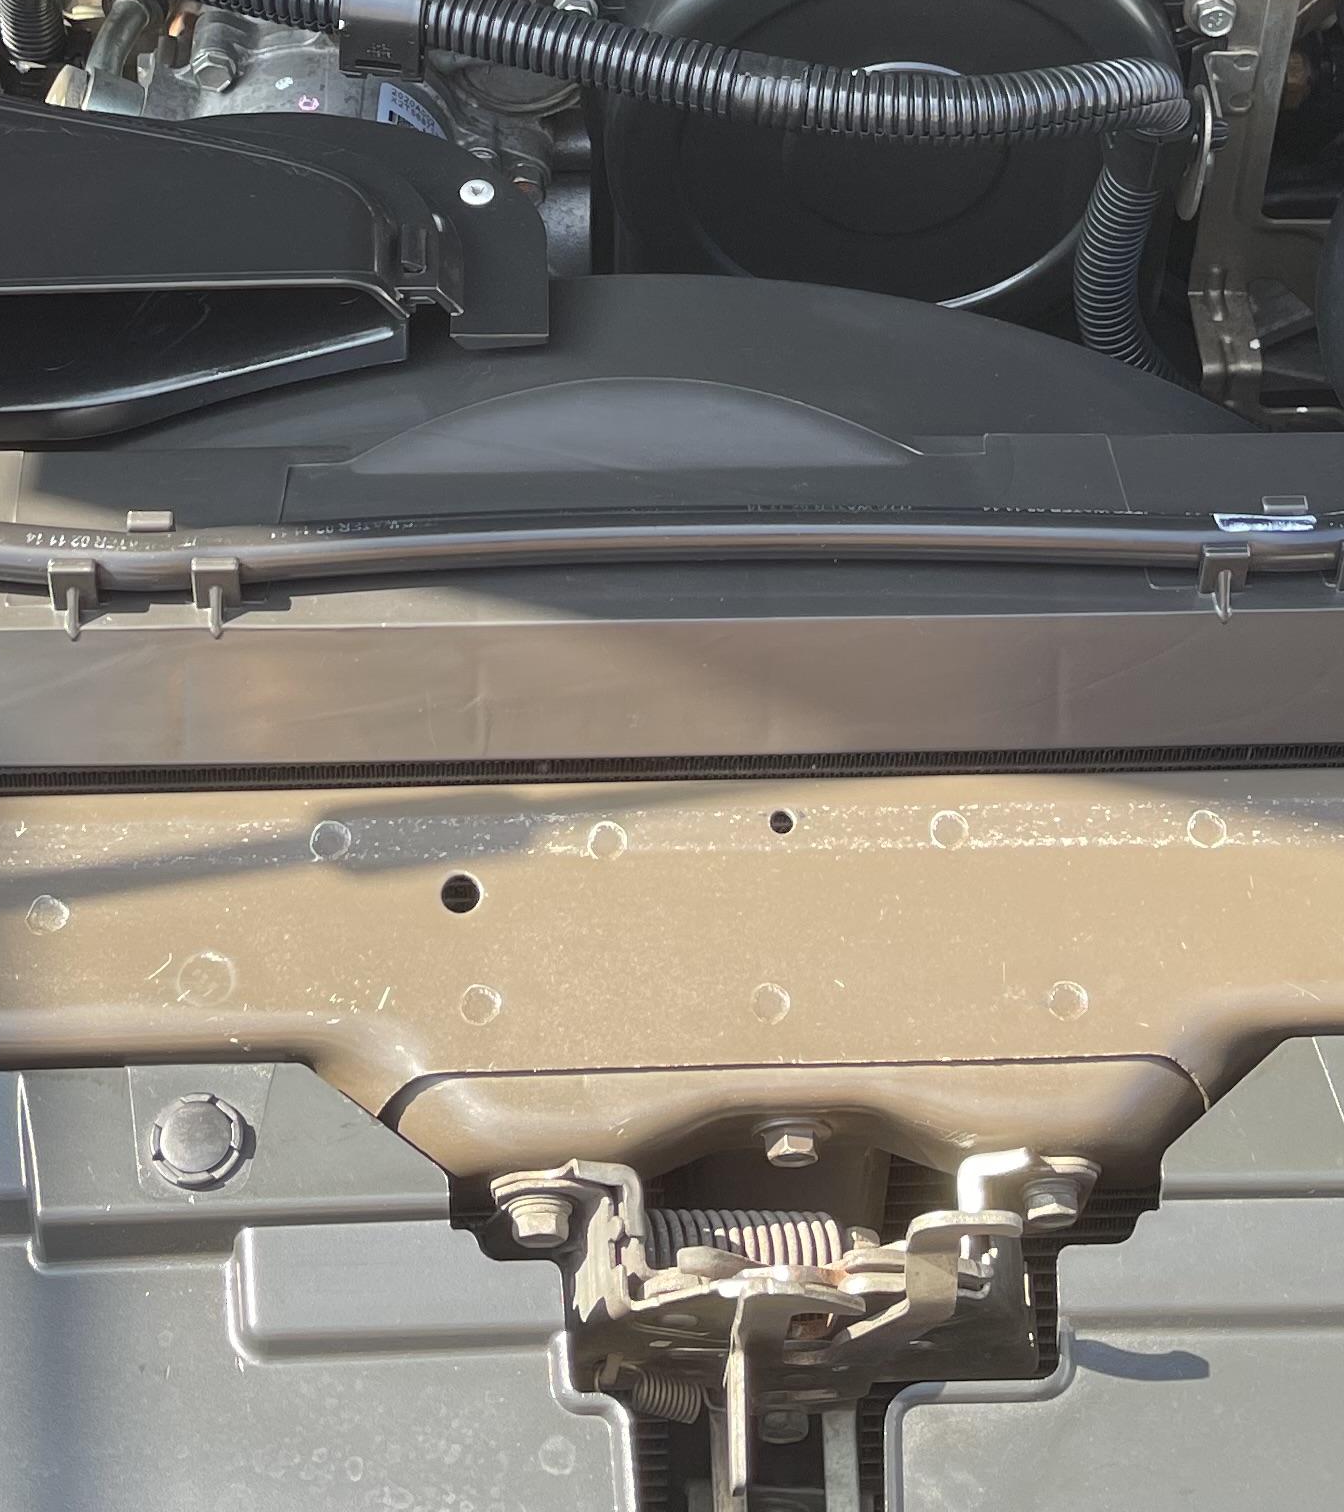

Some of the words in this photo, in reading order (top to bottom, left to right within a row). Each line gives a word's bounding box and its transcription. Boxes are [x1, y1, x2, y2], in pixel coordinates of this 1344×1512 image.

[26, 530, 44, 546] 14
[49, 533, 67, 548] 11
[70, 534, 92, 549] 02
